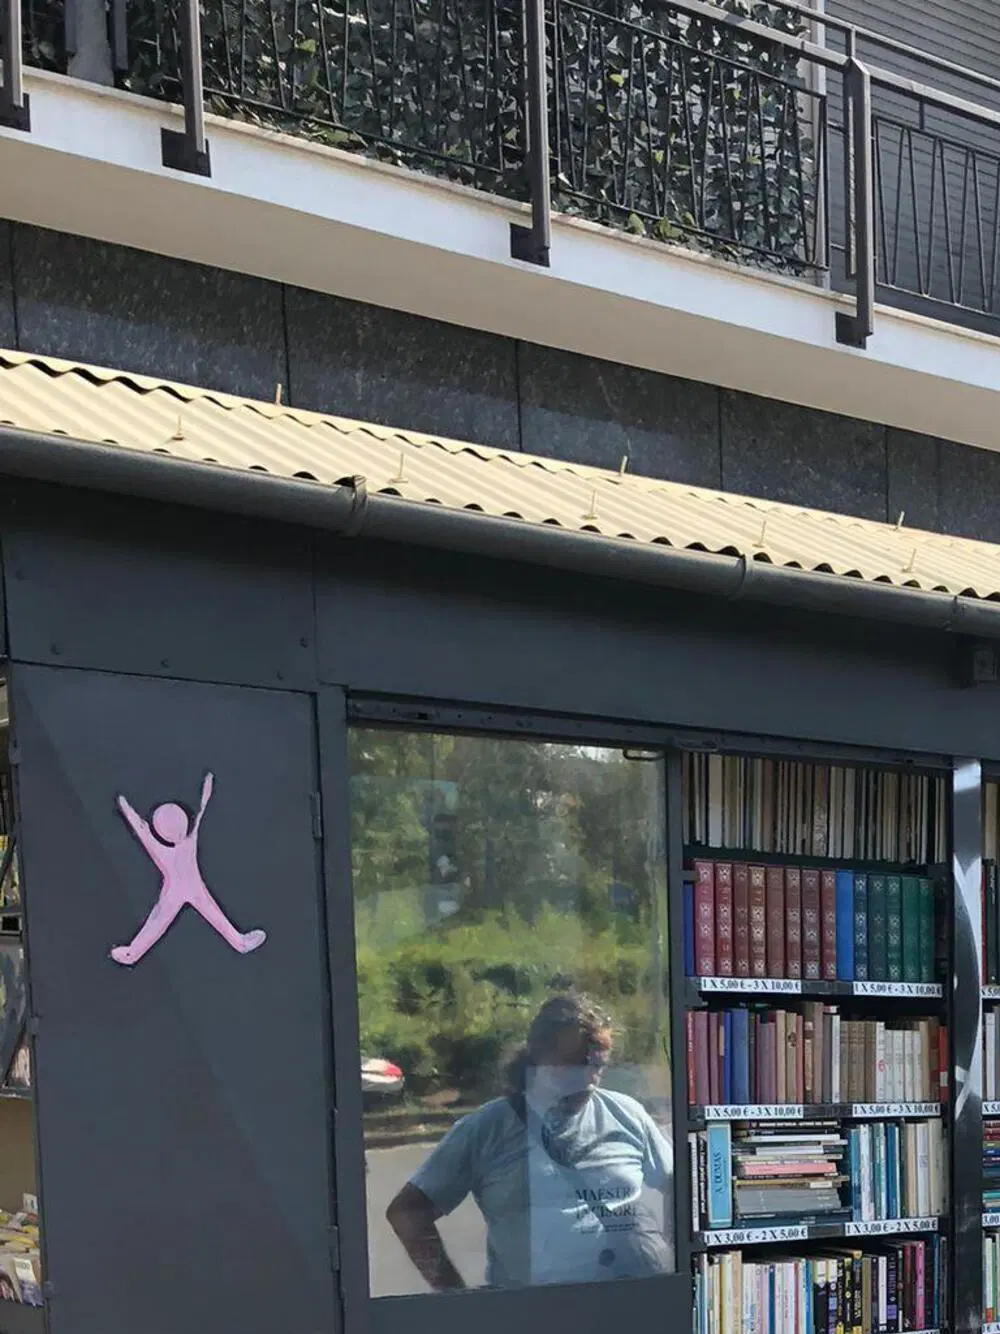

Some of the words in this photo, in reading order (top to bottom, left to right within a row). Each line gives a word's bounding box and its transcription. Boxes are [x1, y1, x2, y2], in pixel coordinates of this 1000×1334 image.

[703, 979, 707, 989] 1
[711, 979, 718, 989] X
[720, 979, 739, 990] 5,00
[740, 980, 747, 990] €
[753, 980, 759, 990] 3
[761, 980, 769, 990] X
[771, 981, 794, 991] 10,00
[795, 981, 802, 991] €
[706, 1107, 710, 1117] 1
[714, 1107, 721, 1117] X
[723, 1107, 741, 1117] 5,00
[743, 1107, 749, 1117] €
[756, 1107, 762, 1117] 3
[764, 1107, 772, 1116] X
[774, 1106, 795, 1116] 10,00
[797, 1106, 803, 1116] €
[847, 1225, 851, 1234] 1
[854, 1224, 861, 1233] X
[863, 1223, 881, 1233] 3,00
[883, 1223, 888, 1233] €
[896, 1222, 901, 1231] 2
[904, 1220, 911, 1231] X
[913, 1220, 930, 1230] 5,00
[931, 1220, 937, 1229] €
[706, 1235, 710, 1244] 1
[714, 1234, 721, 1243] X
[724, 1232, 744, 1244] 3,00
[746, 1231, 753, 1241] €
[761, 1230, 767, 1240] 2
[769, 1229, 777, 1239] X
[780, 1228, 799, 1239] 5,00
[800, 1227, 807, 1237] €
